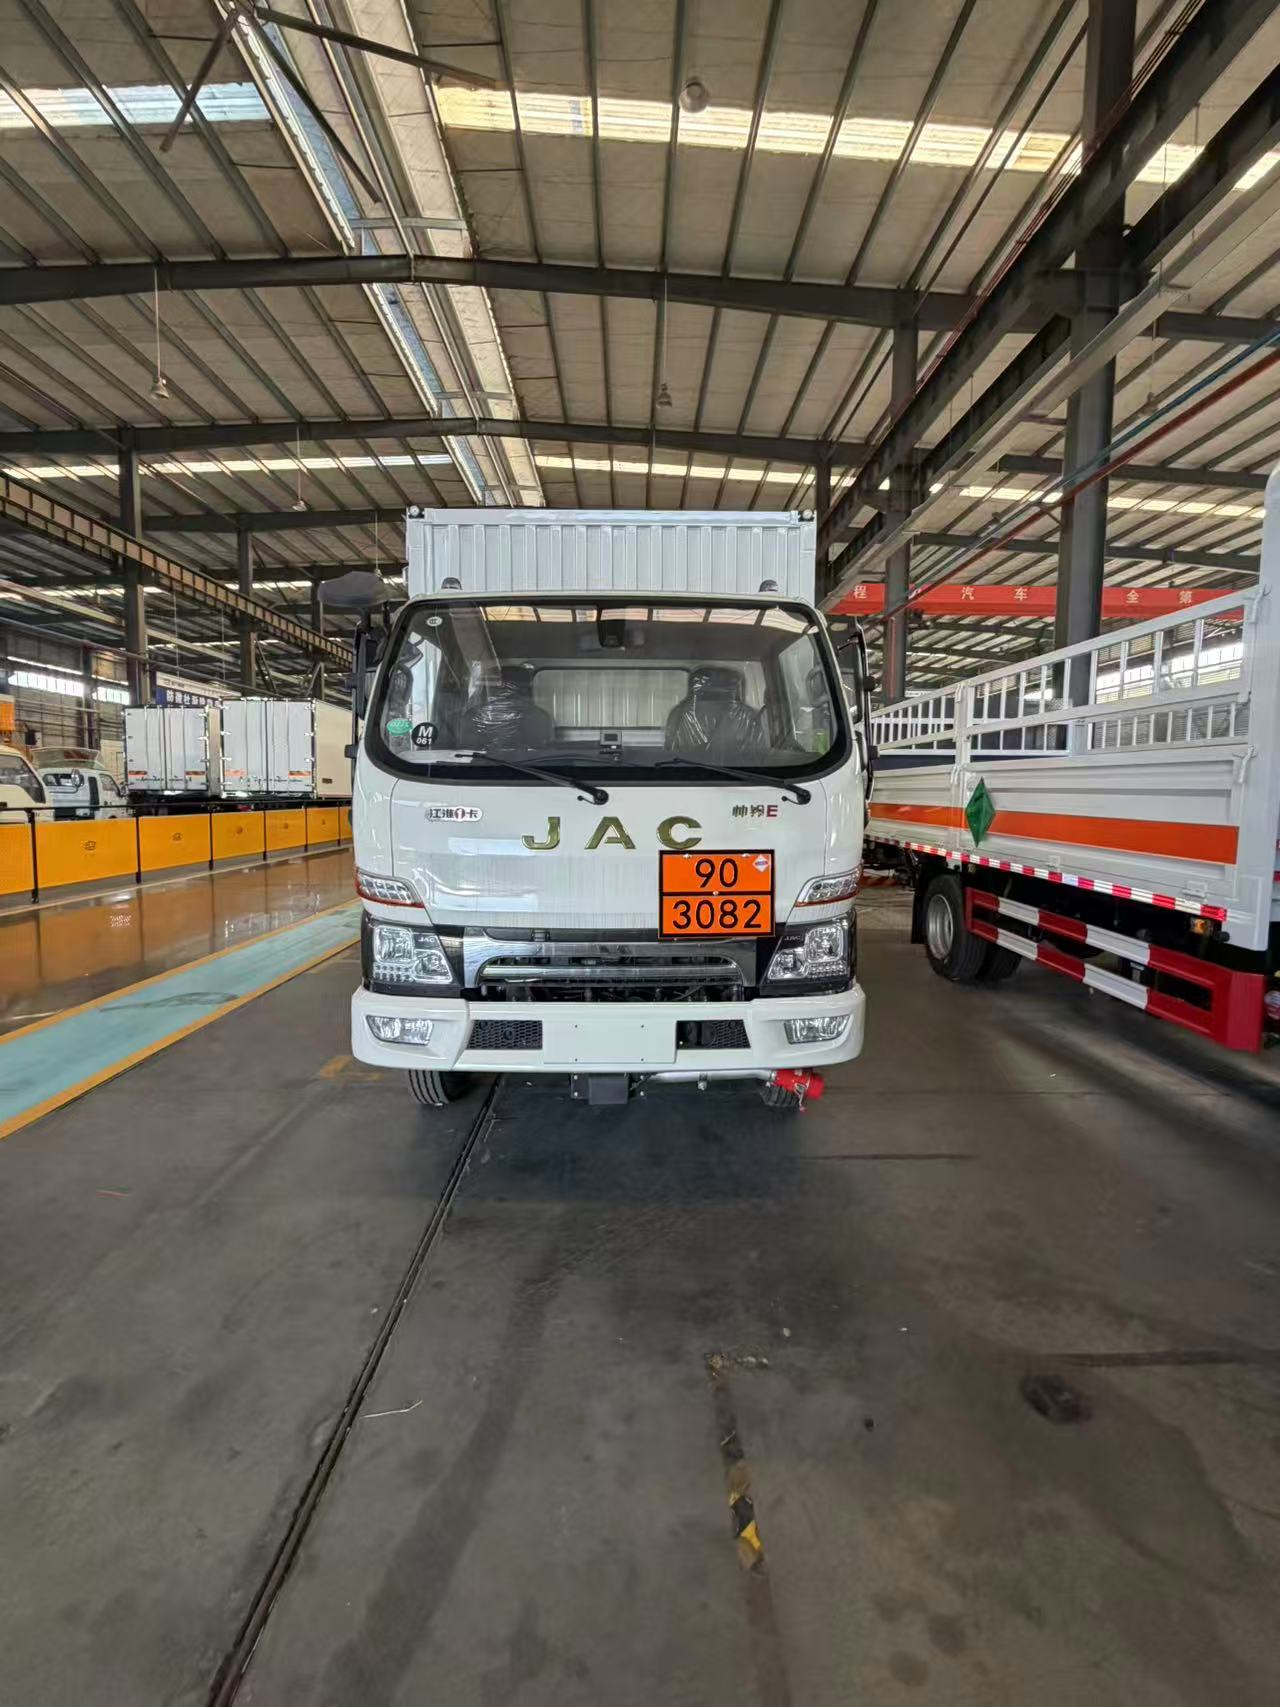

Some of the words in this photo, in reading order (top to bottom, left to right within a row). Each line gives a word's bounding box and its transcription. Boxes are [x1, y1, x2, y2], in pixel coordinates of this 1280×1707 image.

[416, 737, 433, 745] 061
[418, 725, 434, 738] M
[522, 816, 702, 850] JAC
[695, 858, 738, 888] 90
[672, 899, 762, 930] 3082
